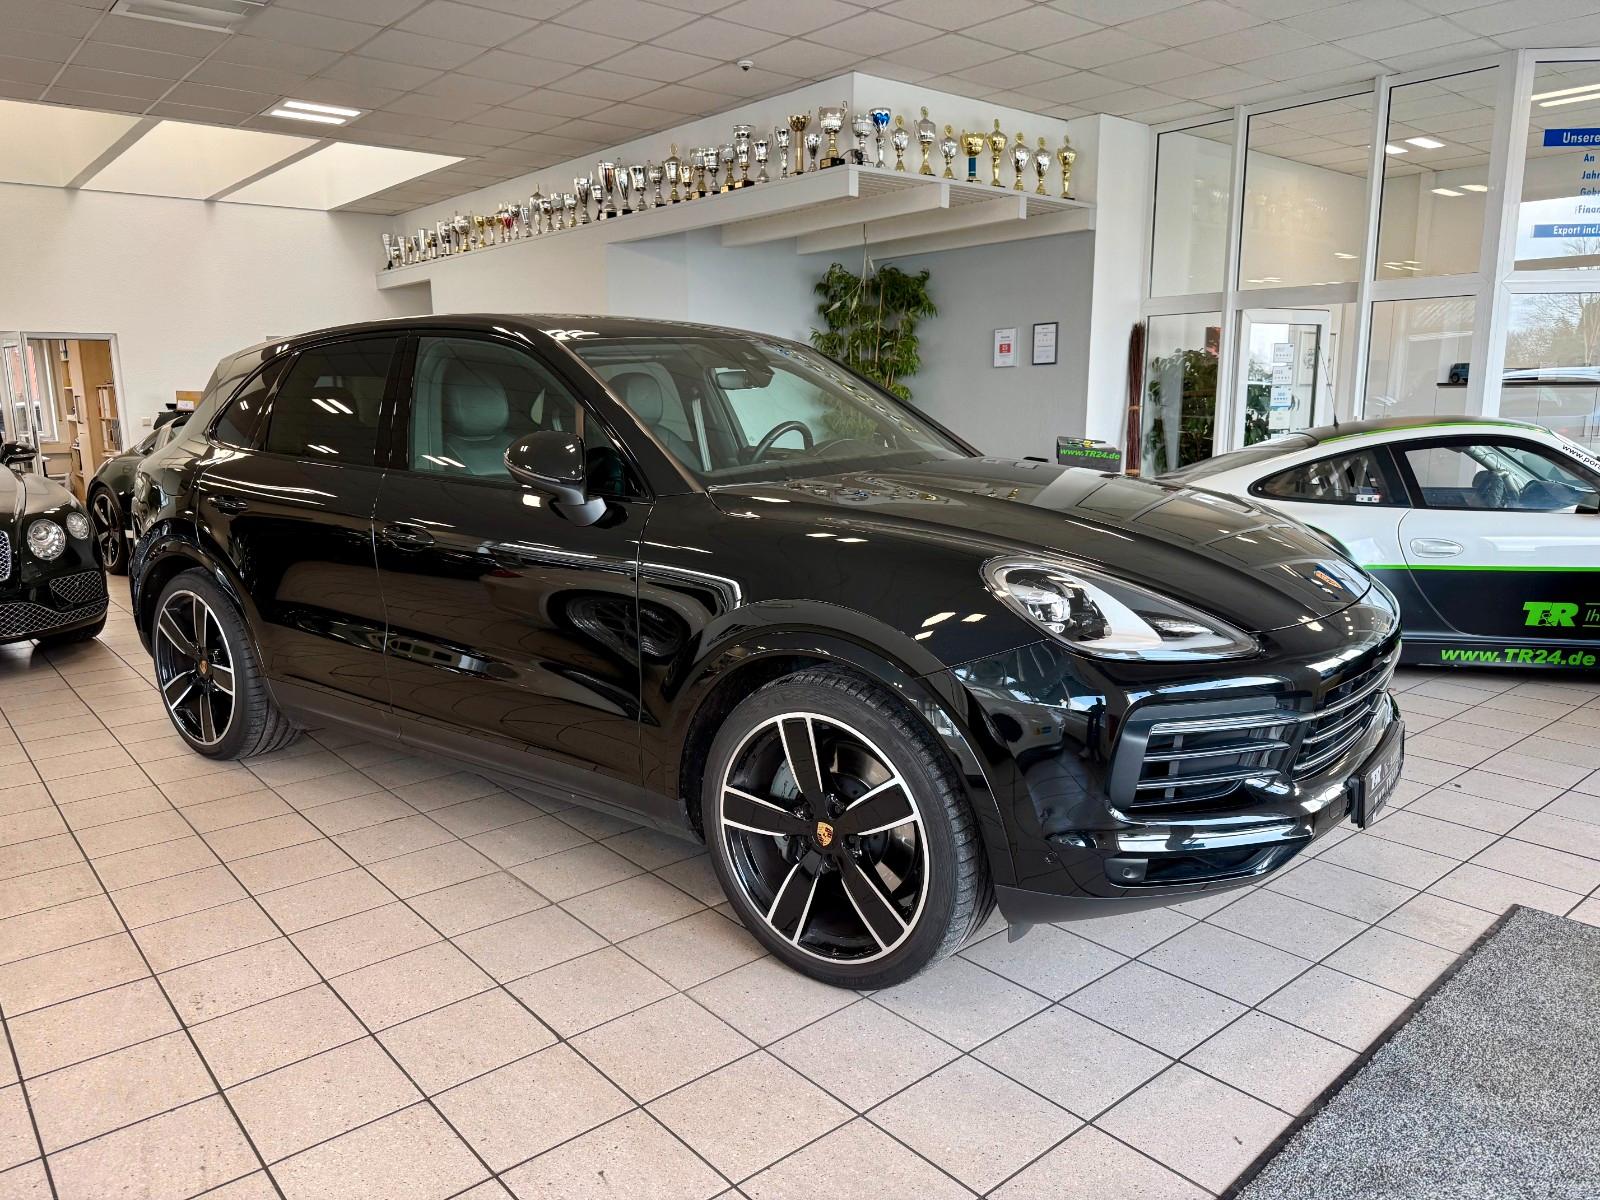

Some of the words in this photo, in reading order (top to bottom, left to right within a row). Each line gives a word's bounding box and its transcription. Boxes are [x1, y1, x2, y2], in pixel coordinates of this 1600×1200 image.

[1562, 132, 1600, 144] Unsere
[1553, 225, 1580, 236] Export
[1060, 448, 1120, 460] www.TR24.de
[1441, 648, 1596, 666] www.TR24.de
